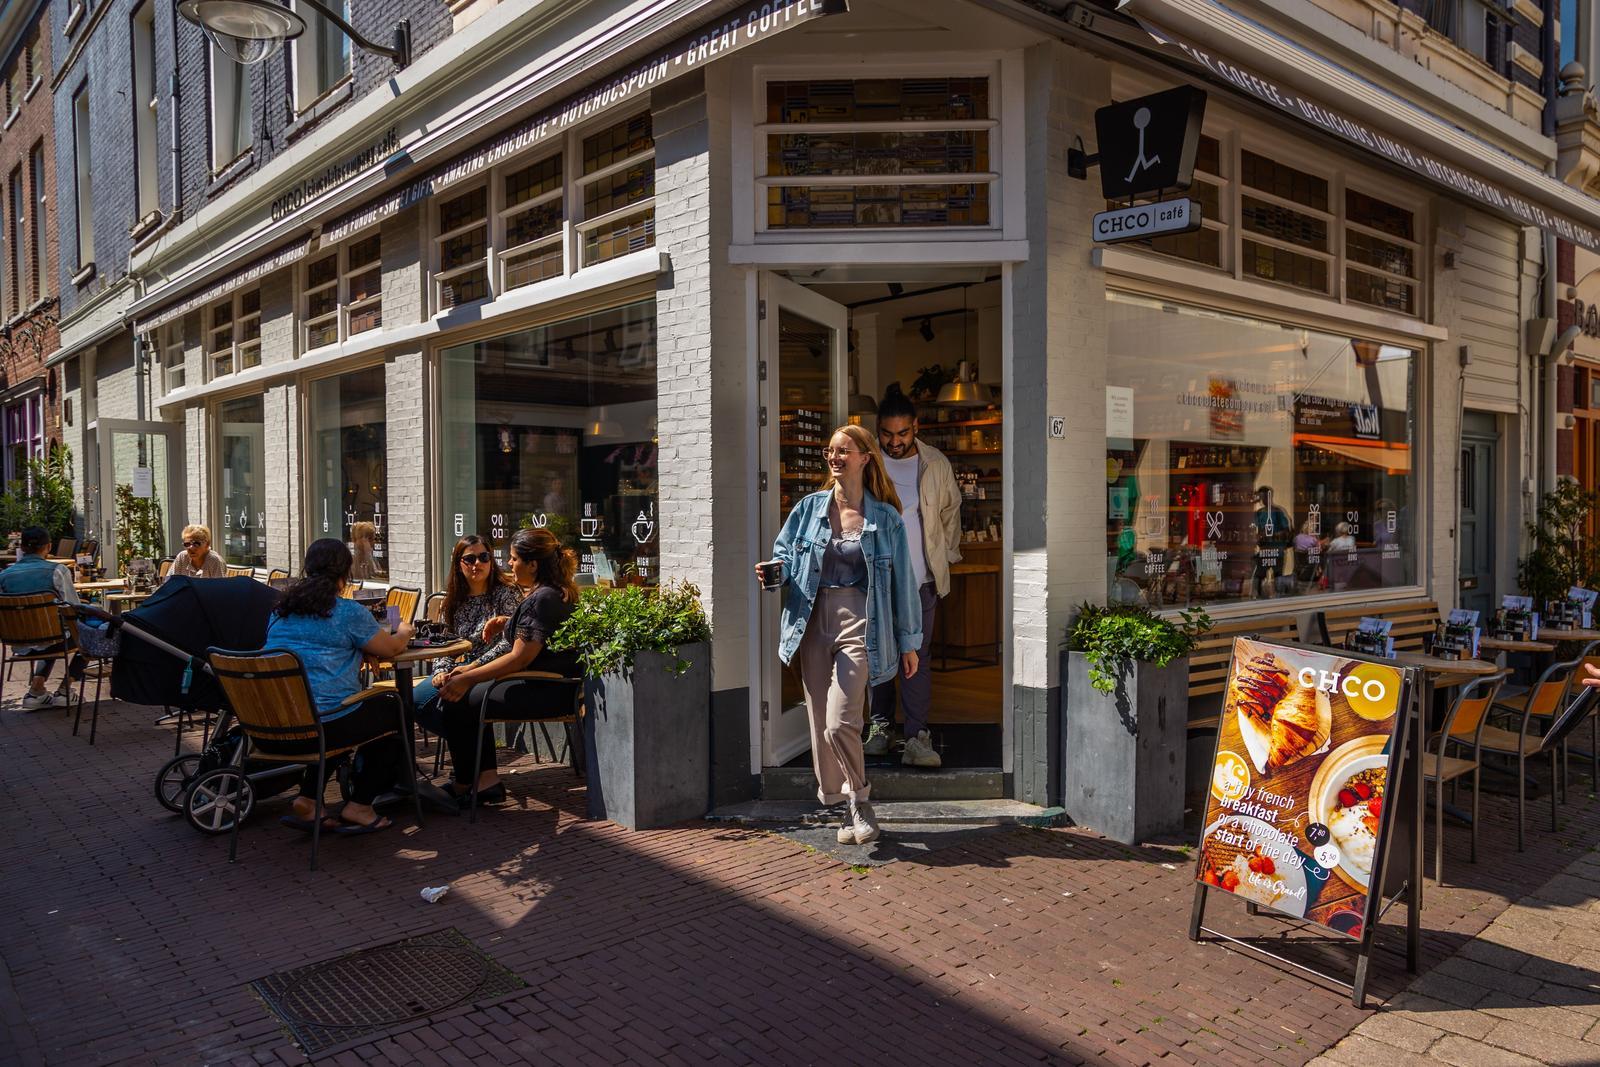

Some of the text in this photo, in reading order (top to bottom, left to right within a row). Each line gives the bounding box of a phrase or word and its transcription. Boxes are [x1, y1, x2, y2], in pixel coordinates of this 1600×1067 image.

[687, 0, 823, 66] GREAT COFFEE
[560, 54, 670, 127] HOTCHOCSPOON
[1218, 61, 1287, 106] COFFEE
[1297, 97, 1416, 168] DELICIOUS LUNCH
[443, 115, 549, 186] AMAZING CHOCOLATE
[383, 174, 435, 216] SWEET GIFTS
[1422, 156, 1505, 208] HOTCHOCSPOON
[1099, 205, 1184, 234] CHCO café
[1509, 196, 1550, 228] HIGH TEA
[1554, 216, 1595, 249] HIGH CHOC
[1054, 420, 1064, 434] 67
[636, 556, 649, 567] HIGH
[638, 567, 648, 577] TEA
[1144, 563, 1165, 574] COFFEE
[1146, 553, 1164, 563] GREAT
[1298, 667, 1385, 702] CHCO
[1220, 794, 1279, 823] breakfast
[1224, 781, 1295, 810] a tiny french
[1217, 813, 1299, 848] or a chocolate
[1214, 829, 1306, 869] start of the day
